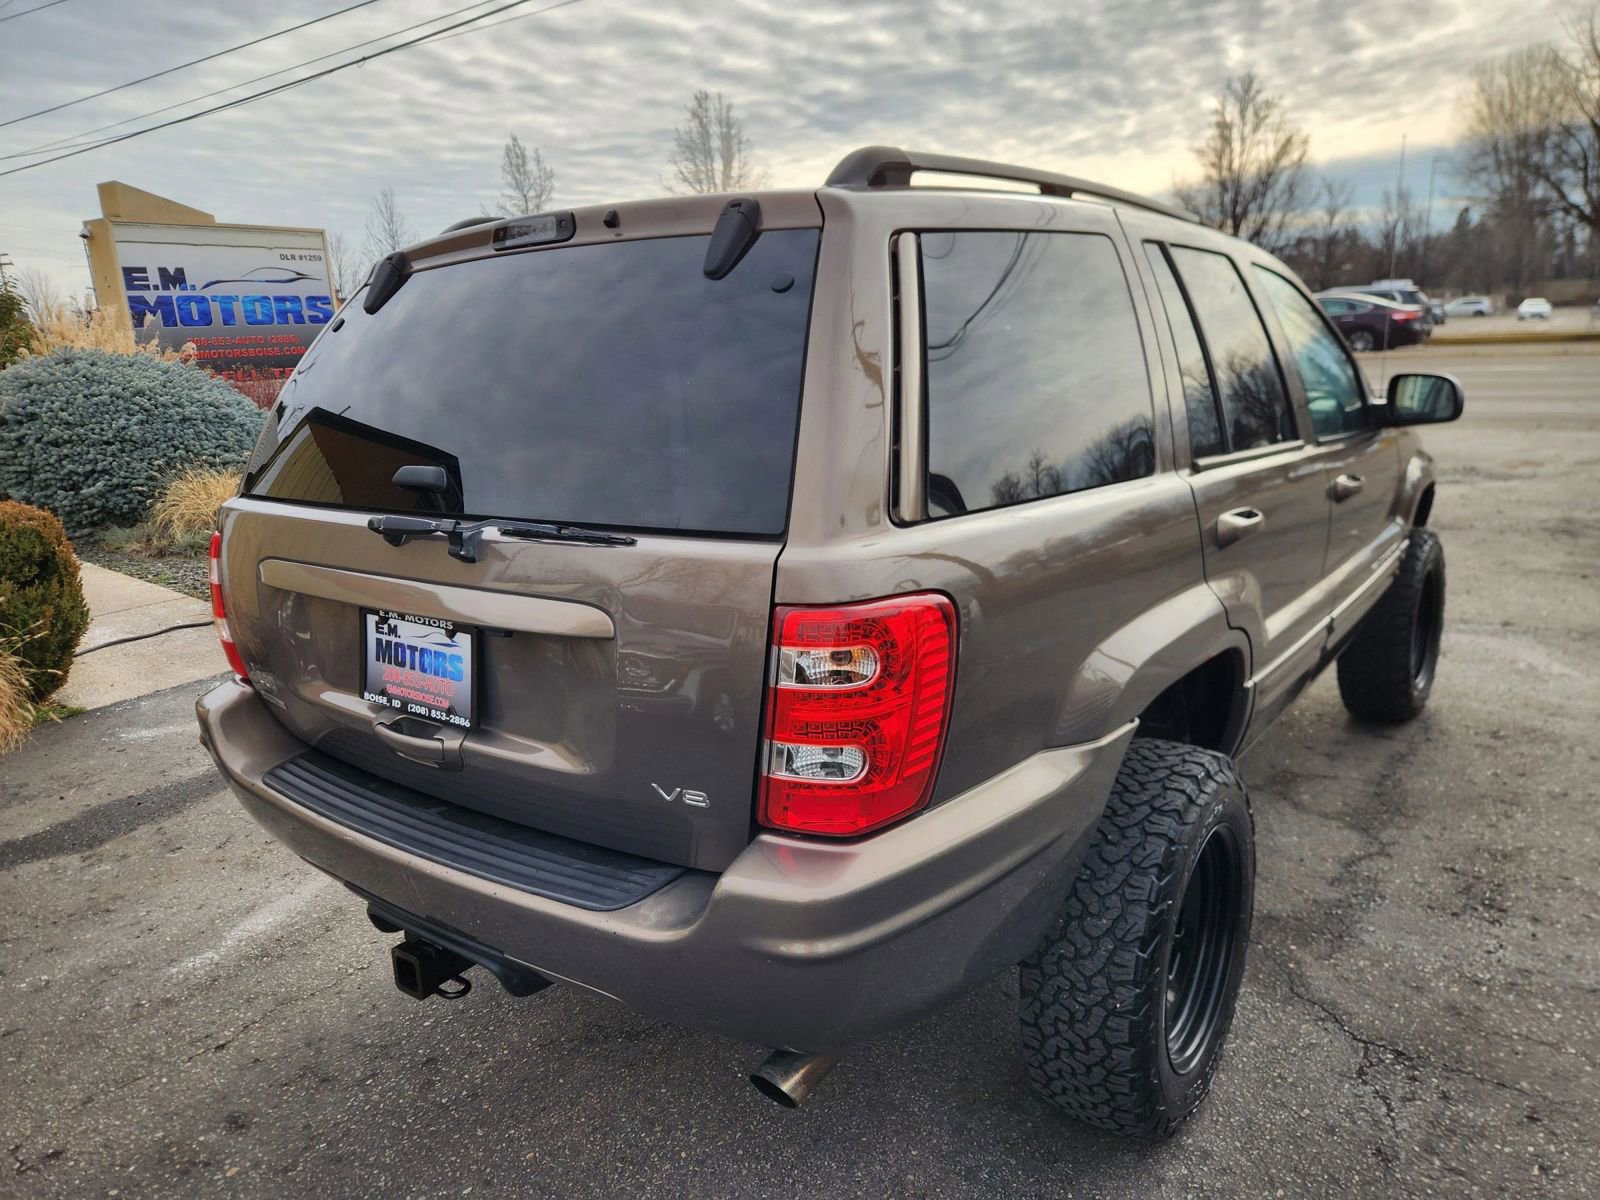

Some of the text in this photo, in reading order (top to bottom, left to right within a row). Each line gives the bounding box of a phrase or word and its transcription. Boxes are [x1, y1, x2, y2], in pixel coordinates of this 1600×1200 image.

[279, 253, 322, 262] DLR #1259
[121, 266, 197, 291] E.M.
[127, 294, 334, 328] MOTORS
[375, 620, 401, 639] E.M.
[379, 609, 454, 630] E.M. MOTORS
[375, 637, 464, 682] MOTORS
[363, 691, 471, 728] BOISE, ID (208) 853-2886
[650, 782, 711, 809] V8
